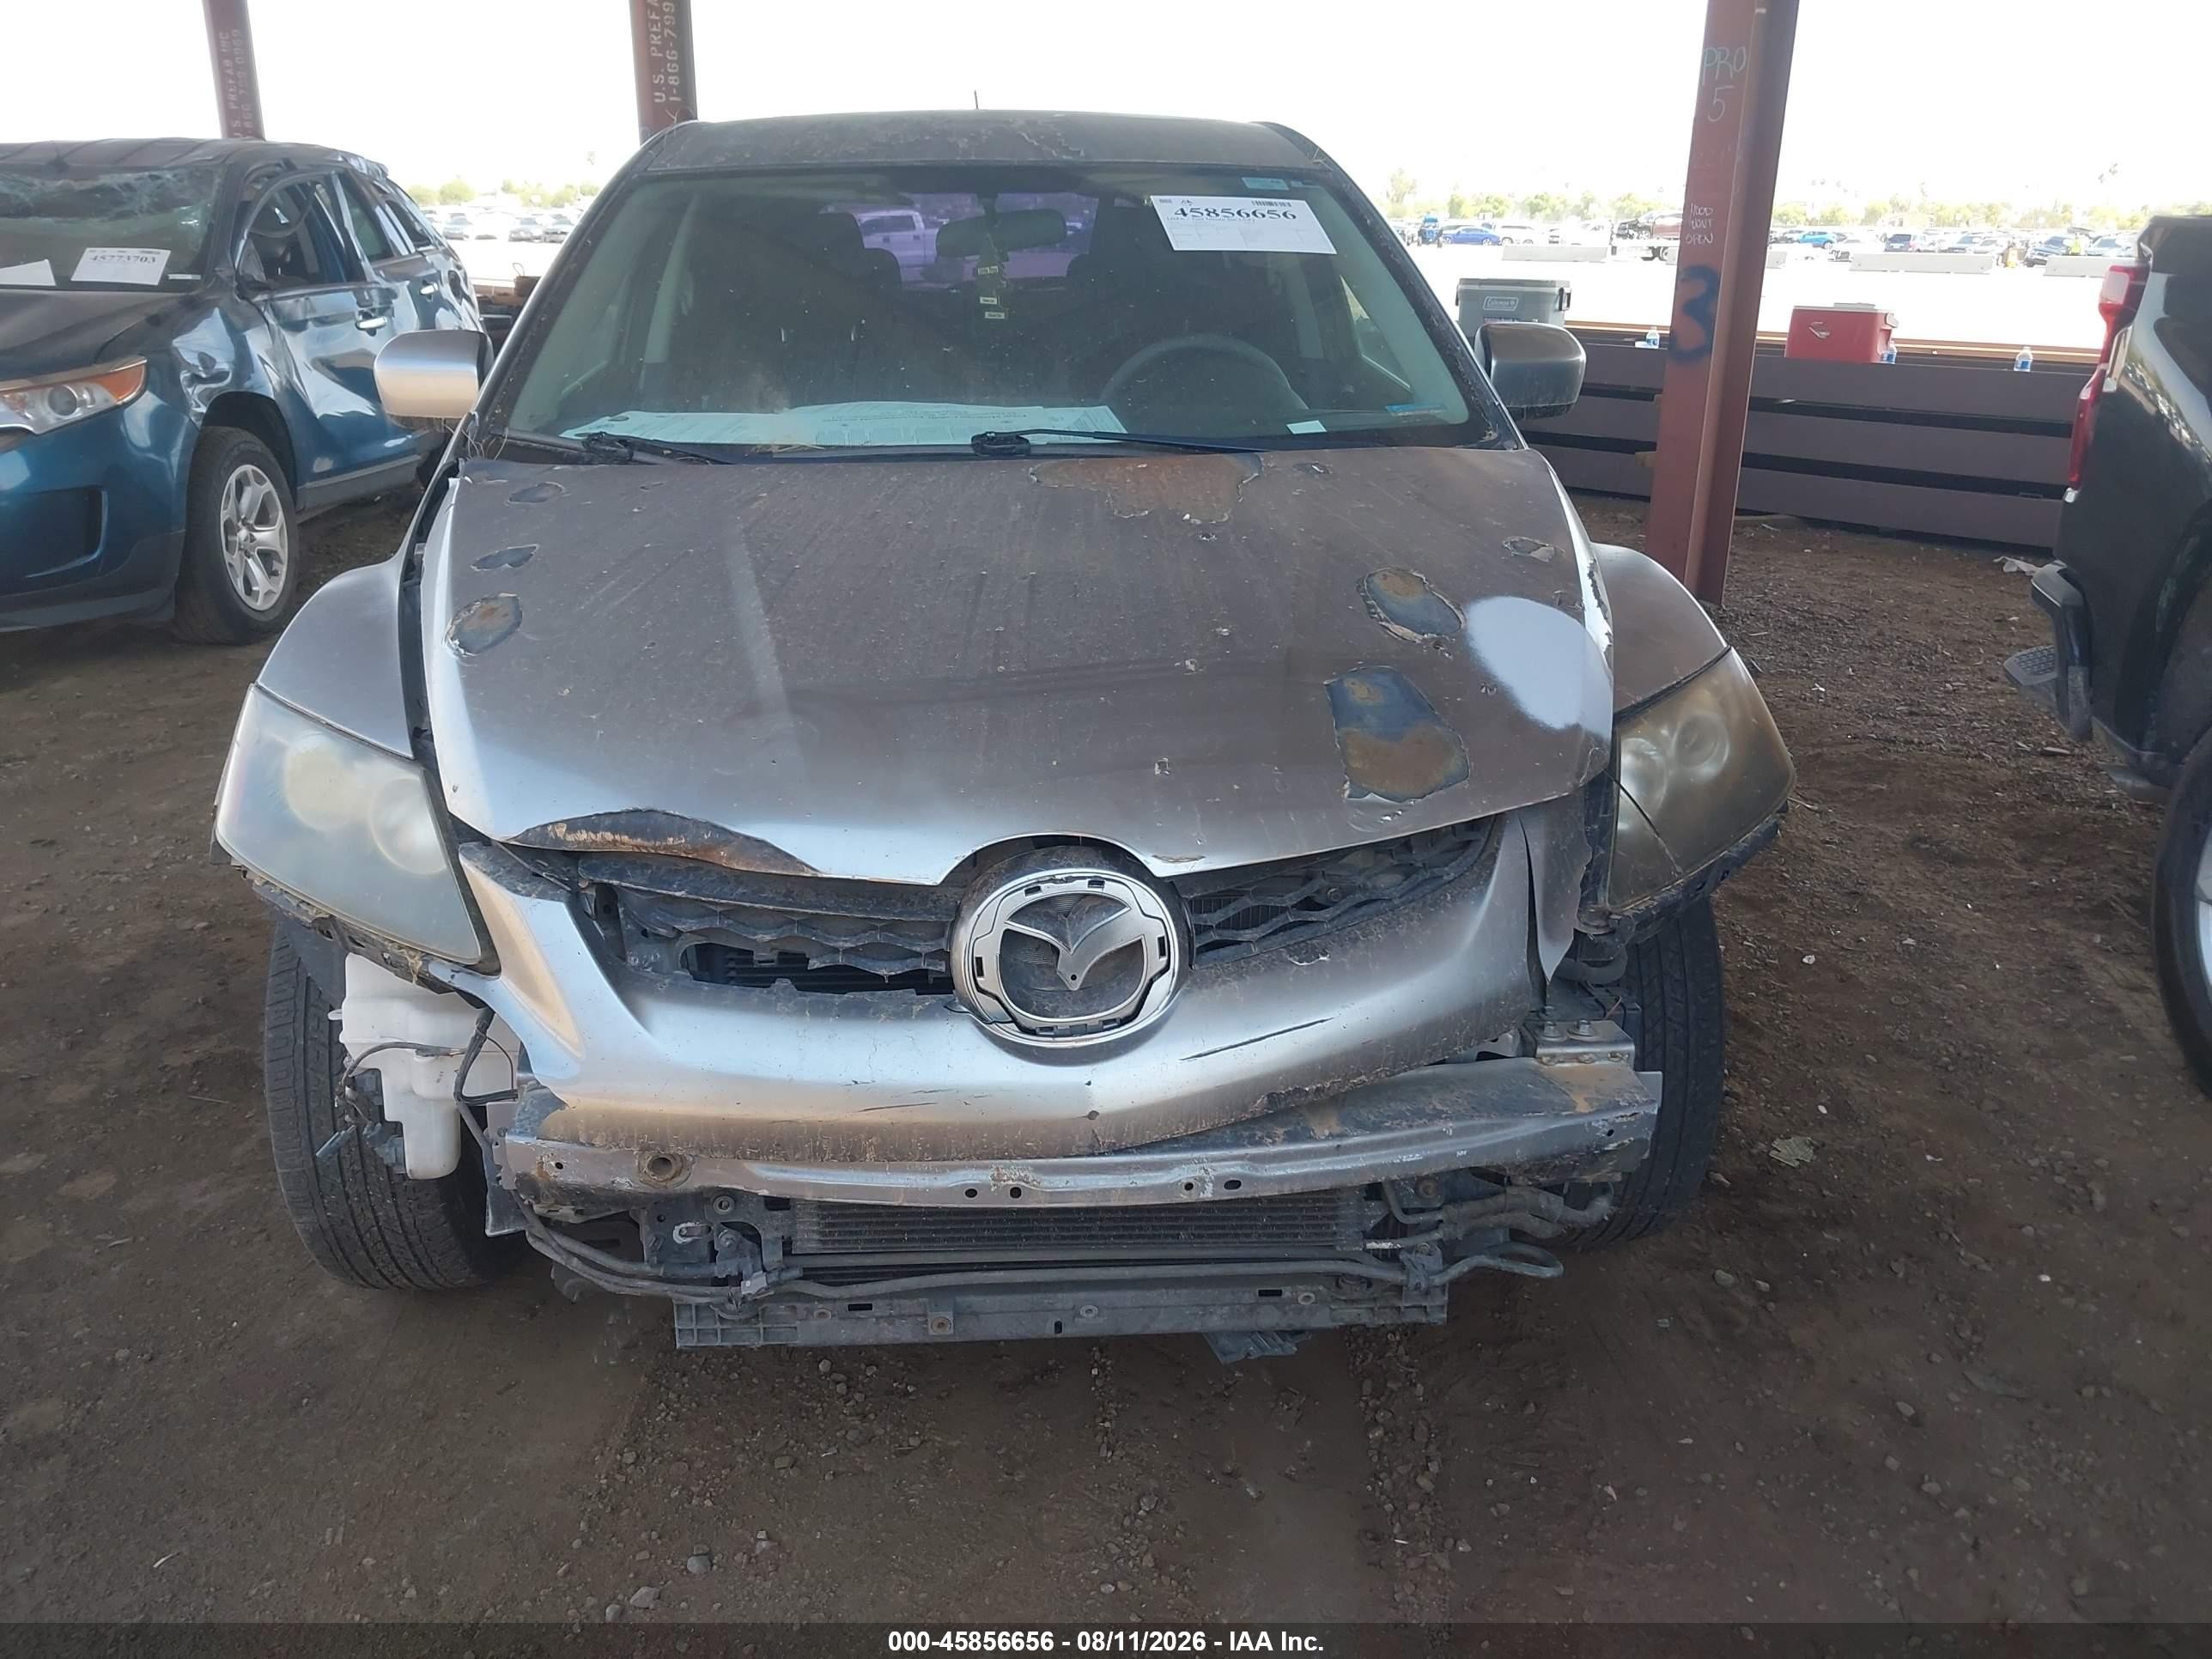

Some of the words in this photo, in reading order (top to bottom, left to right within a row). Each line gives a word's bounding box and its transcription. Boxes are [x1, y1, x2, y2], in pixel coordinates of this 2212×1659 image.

[1703, 46, 1747, 85] PRO
[653, 69, 666, 103] U.S.
[1707, 85, 1735, 122] 5
[1174, 207, 1297, 220] 45856656
[1669, 264, 1721, 366] 3
